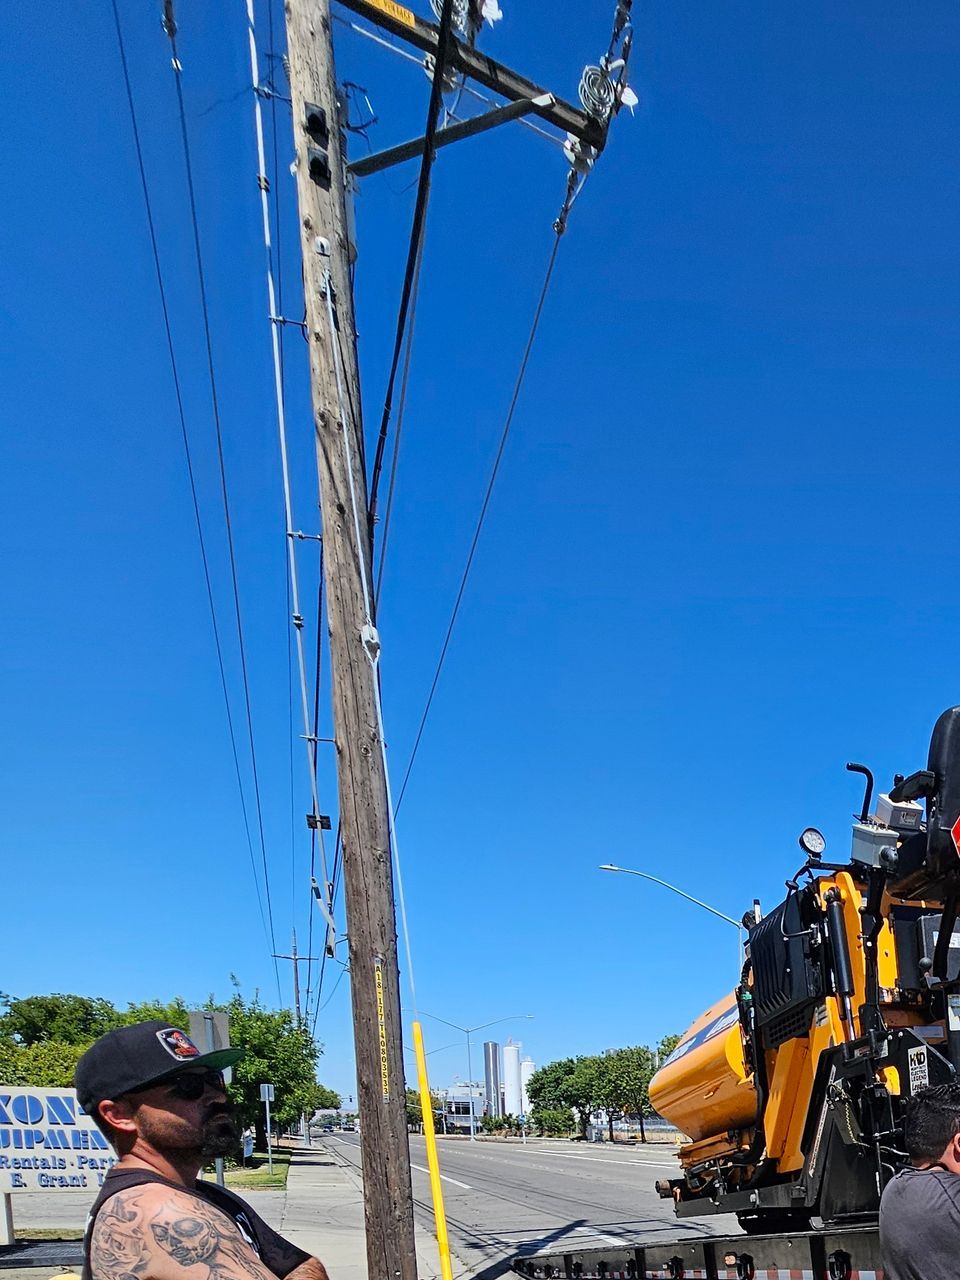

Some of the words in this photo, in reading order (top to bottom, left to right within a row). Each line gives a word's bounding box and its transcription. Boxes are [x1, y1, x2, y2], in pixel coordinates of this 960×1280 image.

[0, 1155, 66, 1170] Rentals
[11, 1173, 27, 1188] E.
[38, 1173, 87, 1188] Grant
